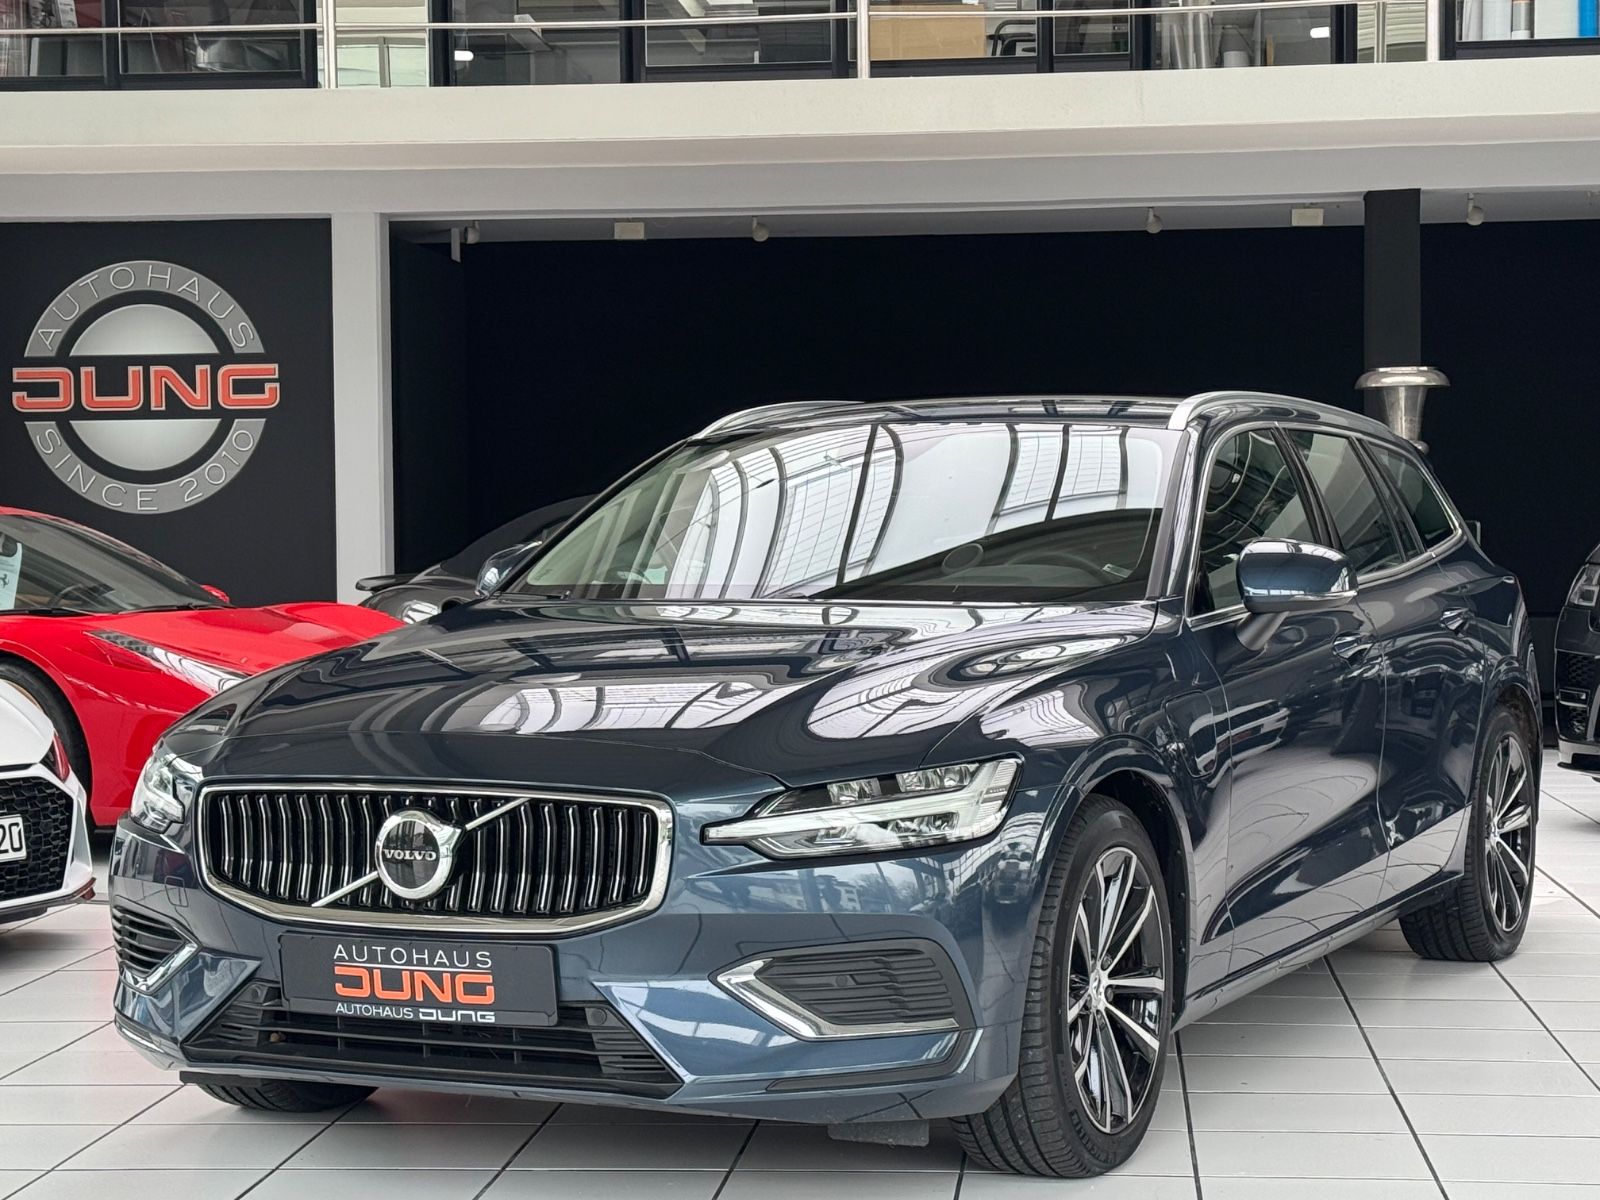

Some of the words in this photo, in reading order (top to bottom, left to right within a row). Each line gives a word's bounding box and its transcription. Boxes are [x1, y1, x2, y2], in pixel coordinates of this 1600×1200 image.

[38, 264, 255, 351] AUTOHAUS
[12, 363, 280, 412] JUNG
[37, 428, 158, 511] SINCE
[179, 430, 254, 502] 2010
[382, 848, 437, 861] VOLVO
[333, 943, 492, 969] AUTOHAUS
[333, 966, 495, 1005] JUNG
[335, 1003, 413, 1019] AUTOHAUS
[418, 1008, 496, 1023] JUNG
